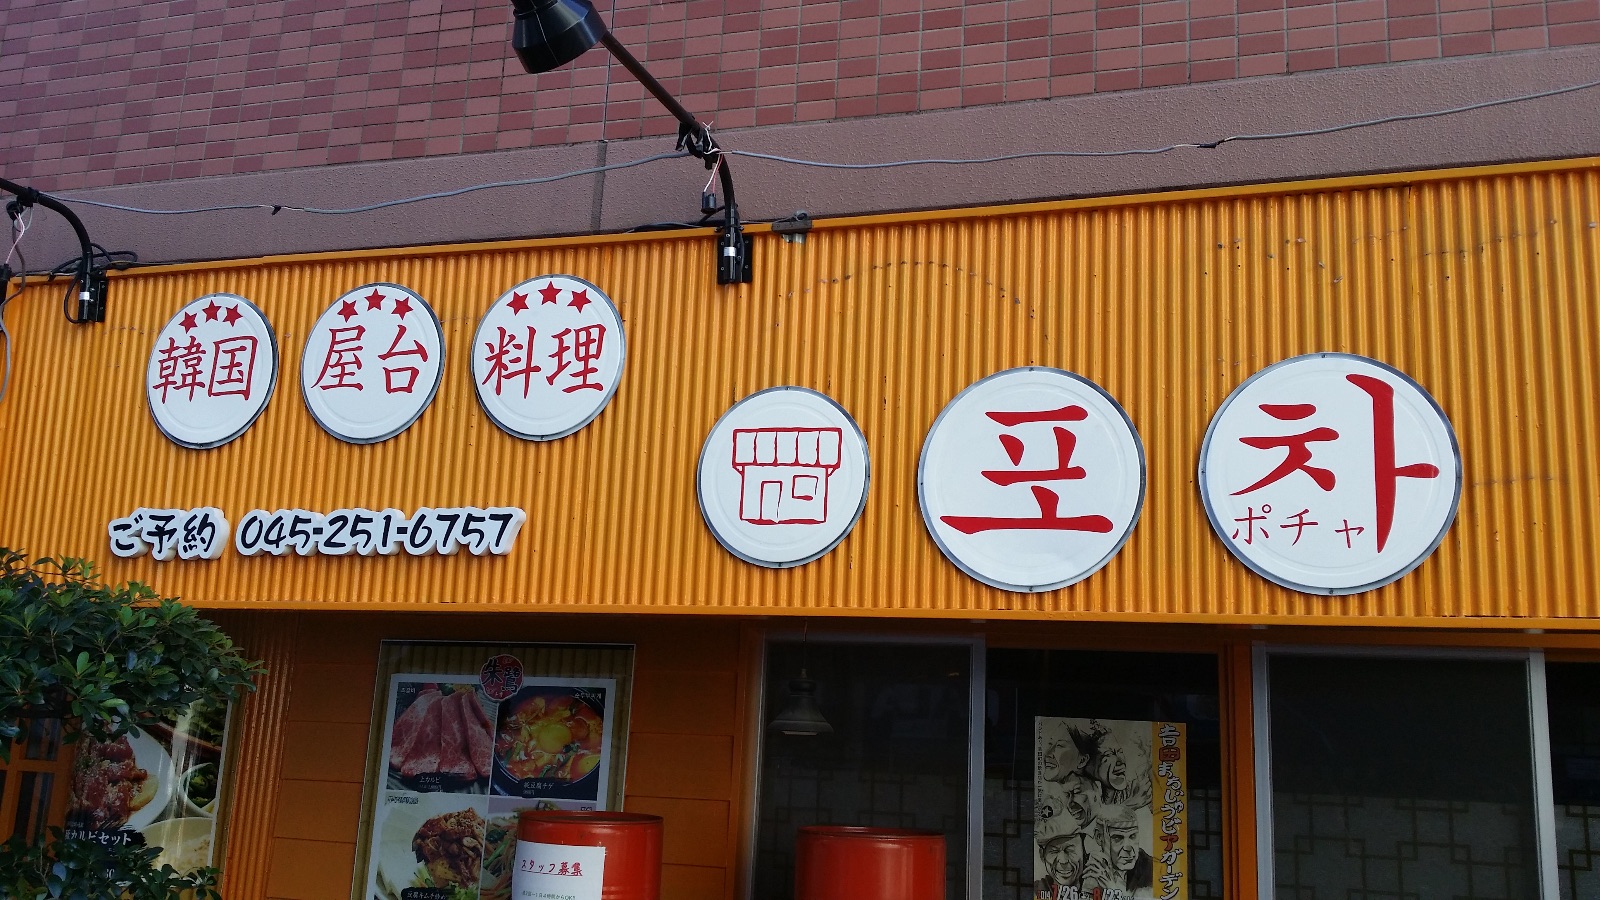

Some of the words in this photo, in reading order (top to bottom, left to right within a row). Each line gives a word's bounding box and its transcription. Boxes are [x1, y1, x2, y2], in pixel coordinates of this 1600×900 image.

[150, 336, 256, 402] 韓国
[310, 325, 428, 394] 屋台
[483, 324, 607, 400] 料理
[112, 513, 216, 553] ご予約
[240, 513, 514, 550] 045-251-6757
[1232, 504, 1366, 549] ポチャ
[521, 859, 583, 876] スタッフ募集
